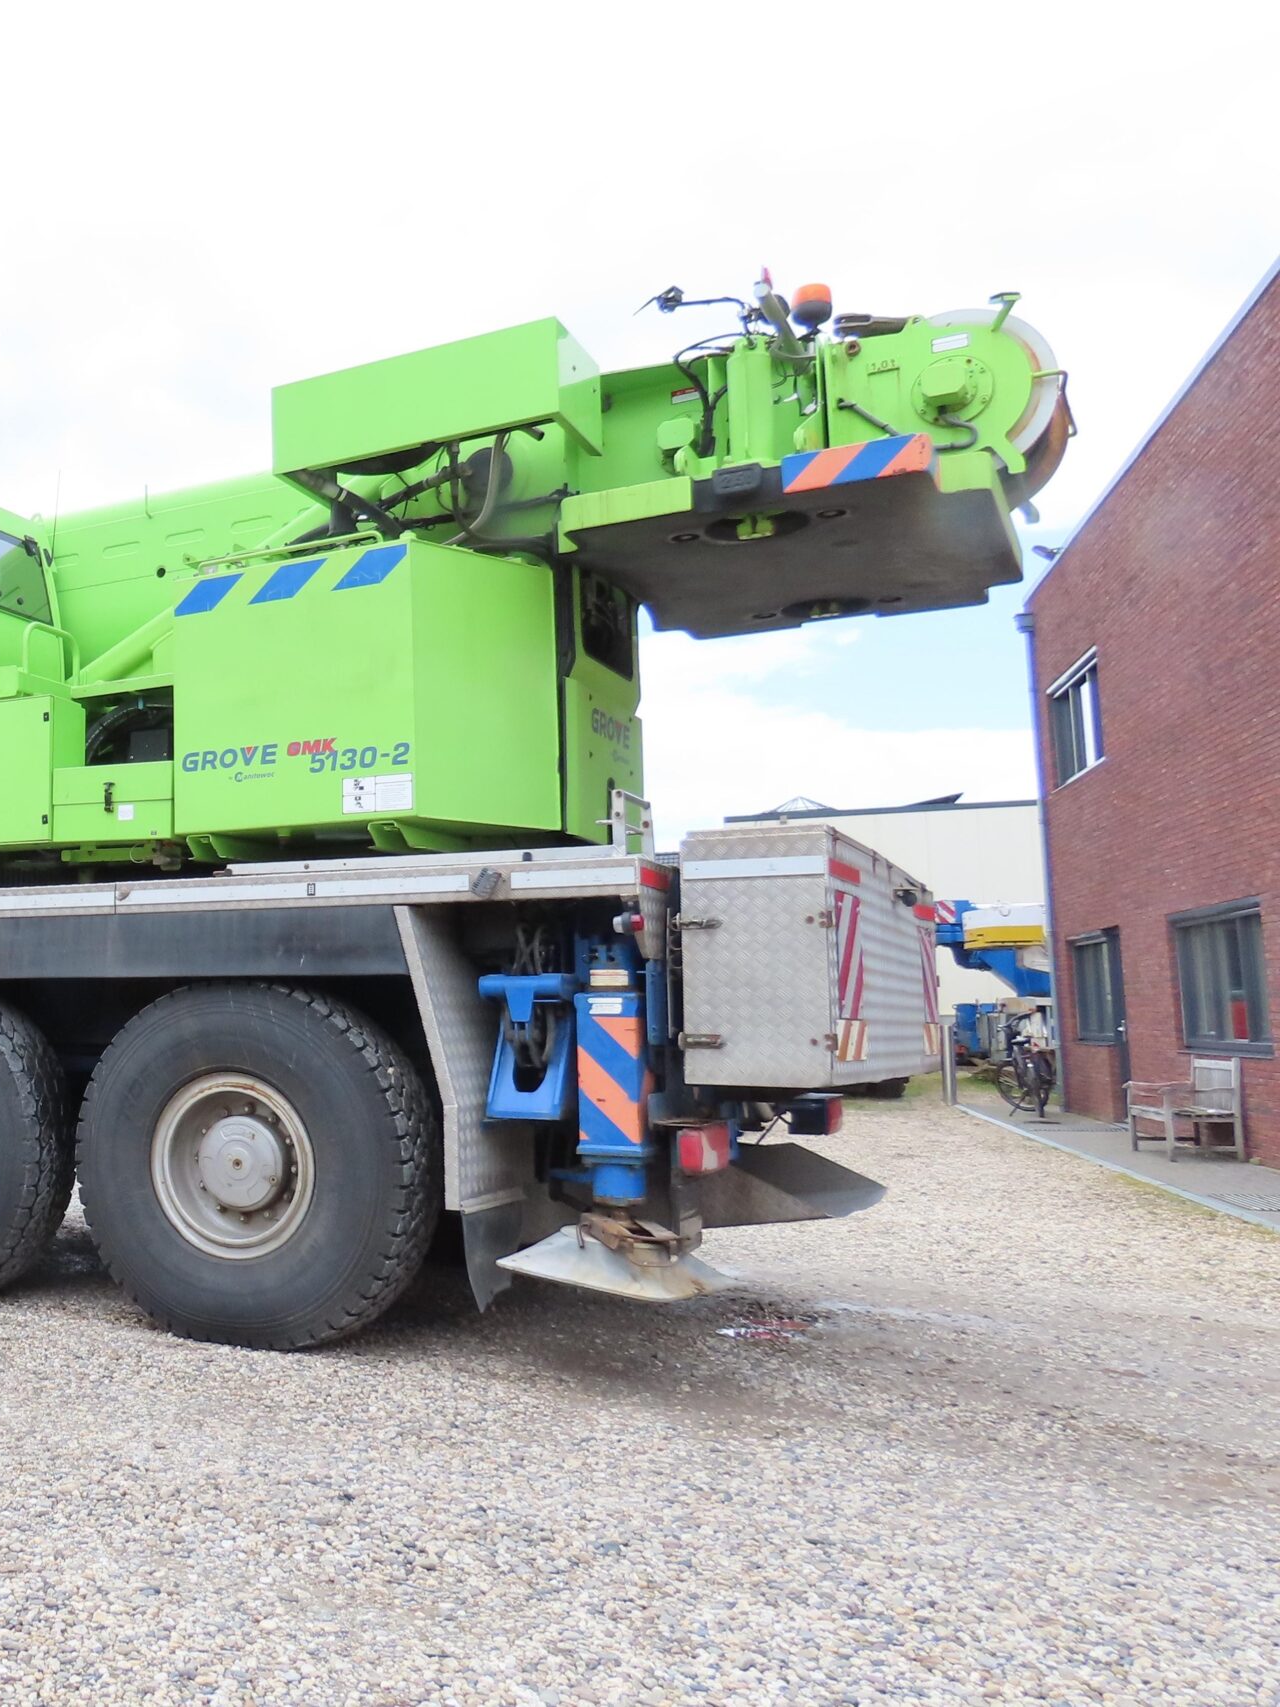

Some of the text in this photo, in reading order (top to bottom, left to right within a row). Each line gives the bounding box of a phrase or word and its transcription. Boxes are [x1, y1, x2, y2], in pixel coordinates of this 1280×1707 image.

[591, 707, 631, 750] GROVE
[182, 744, 278, 772] GROVE
[309, 742, 411, 773] 5130-2
